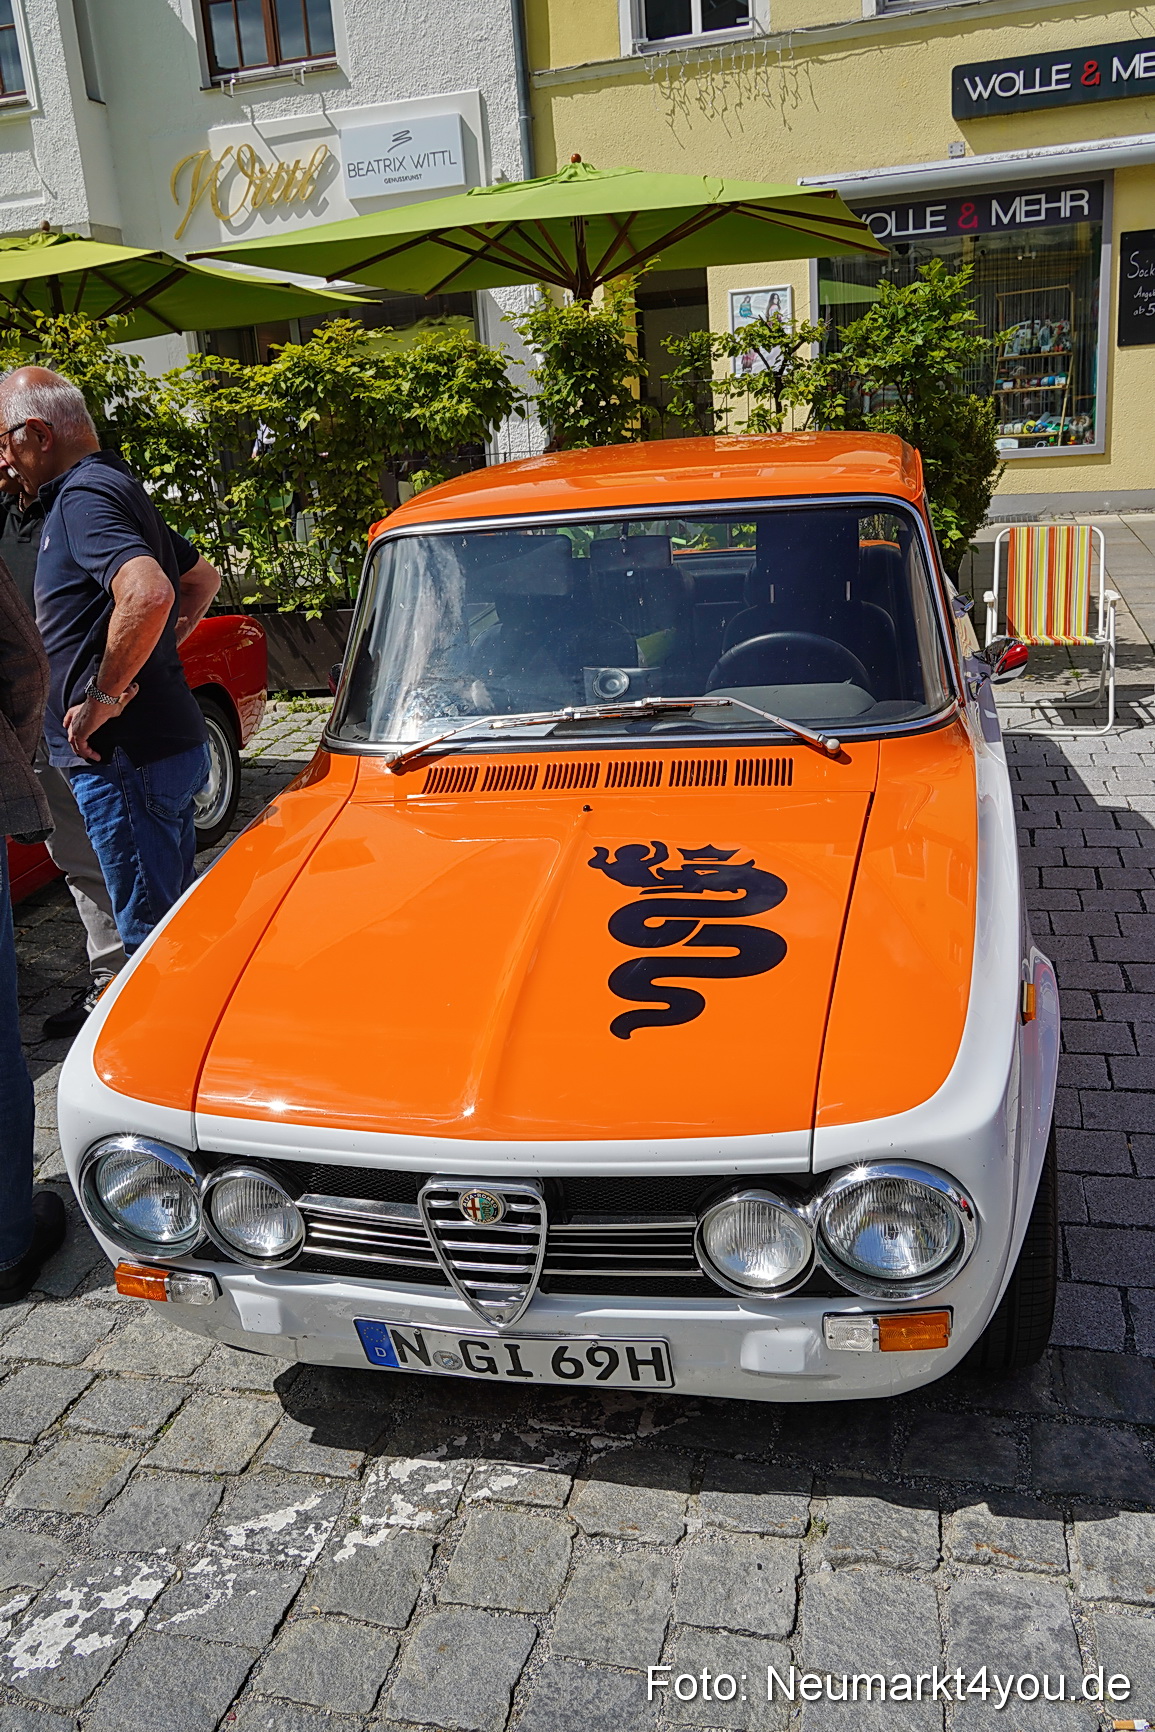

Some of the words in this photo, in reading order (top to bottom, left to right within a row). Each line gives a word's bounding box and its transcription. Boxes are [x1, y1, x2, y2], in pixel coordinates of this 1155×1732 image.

[963, 63, 1072, 102] WOLLE
[1080, 60, 1101, 86] &
[347, 156, 408, 179] BEATRIX
[410, 149, 458, 169] WITTL
[383, 174, 423, 185] GENUSSKUNST
[861, 204, 947, 240] OLLE
[957, 202, 978, 229] &
[991, 189, 1090, 226] MEHR
[1133, 305, 1146, 316] ab
[376, 1346, 387, 1358] D
[551, 1345, 667, 1382] 69H
